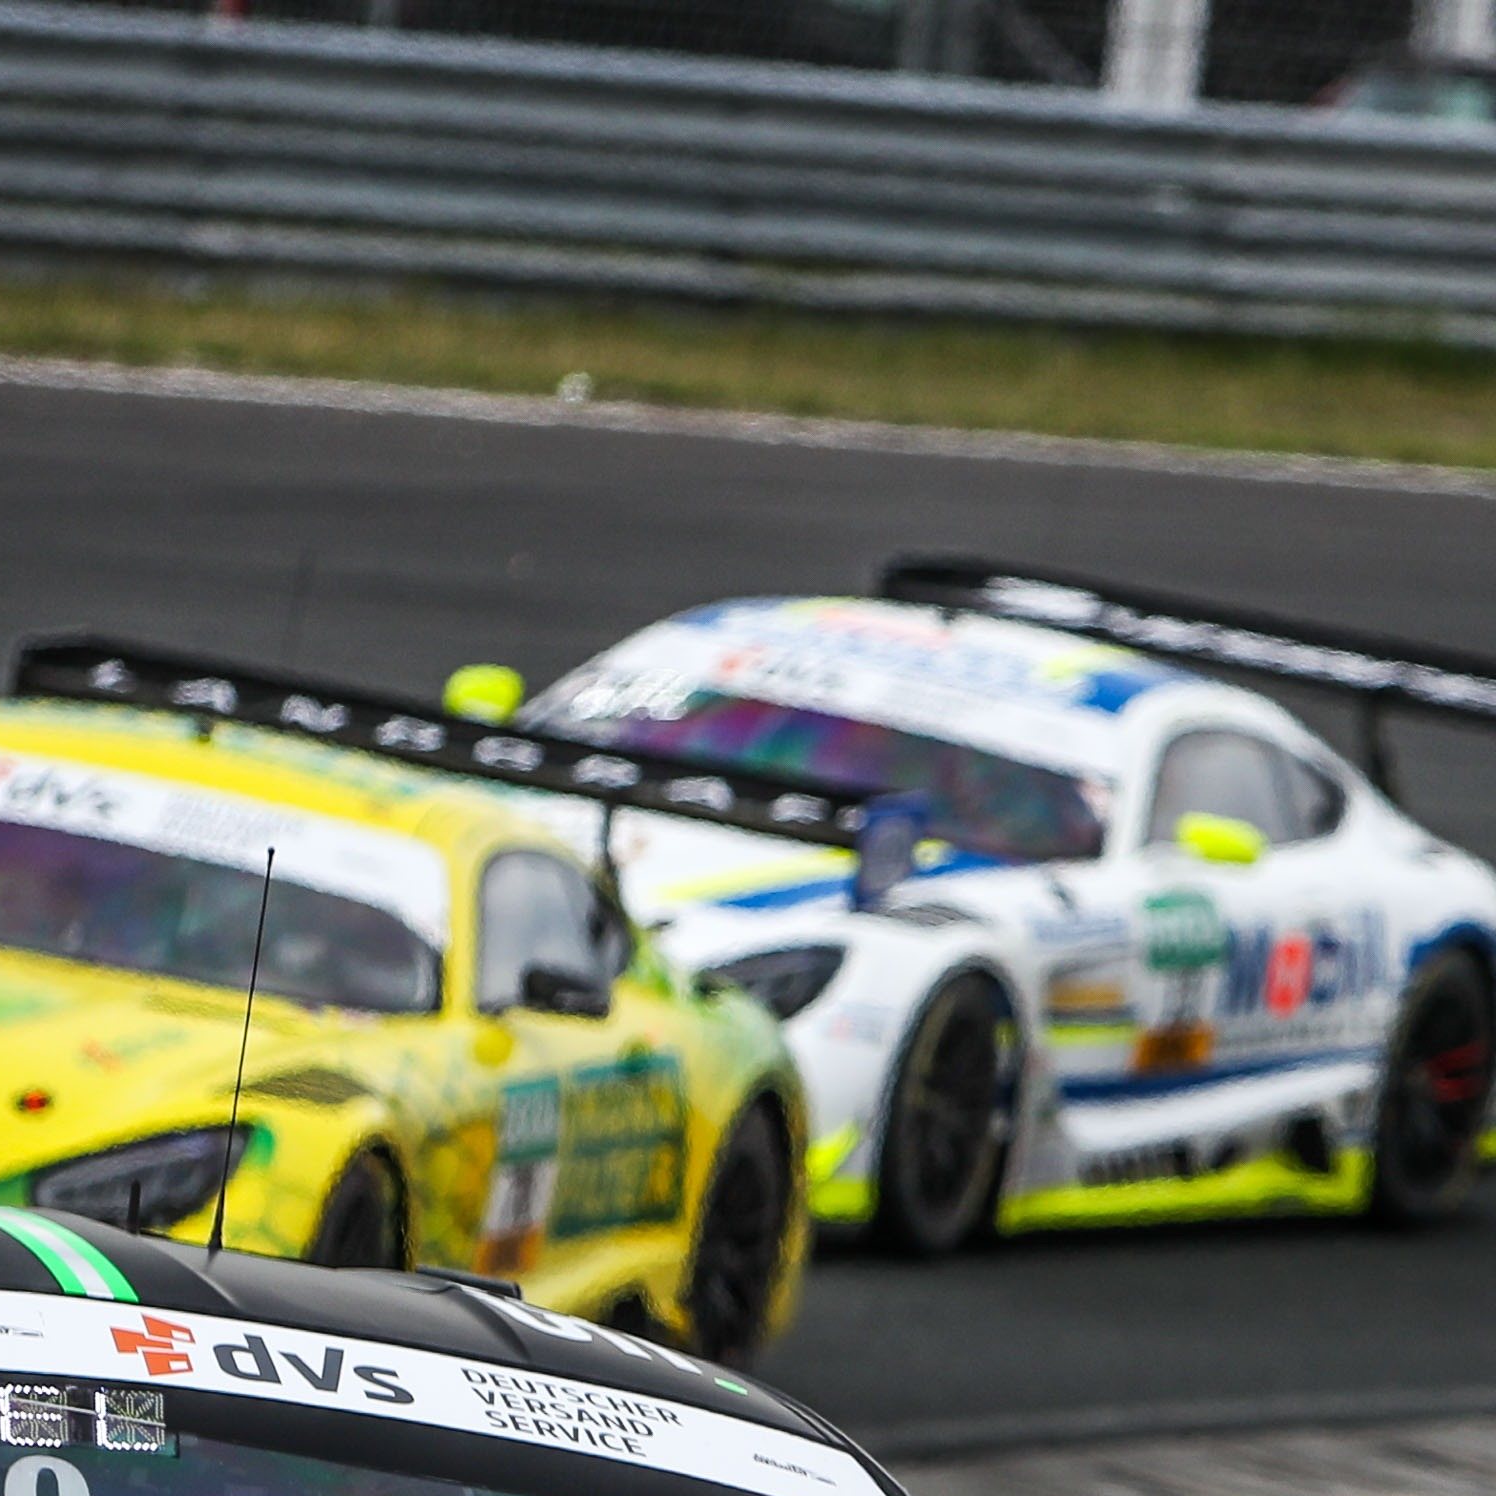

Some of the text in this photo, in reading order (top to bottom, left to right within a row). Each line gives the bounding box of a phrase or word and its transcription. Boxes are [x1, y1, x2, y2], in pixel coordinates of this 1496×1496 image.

[211, 1333, 416, 1405] dvs
[460, 1367, 685, 1428] DEUTSCHER
[471, 1387, 654, 1438] VERSAND
[484, 1410, 648, 1459] SERVICE
